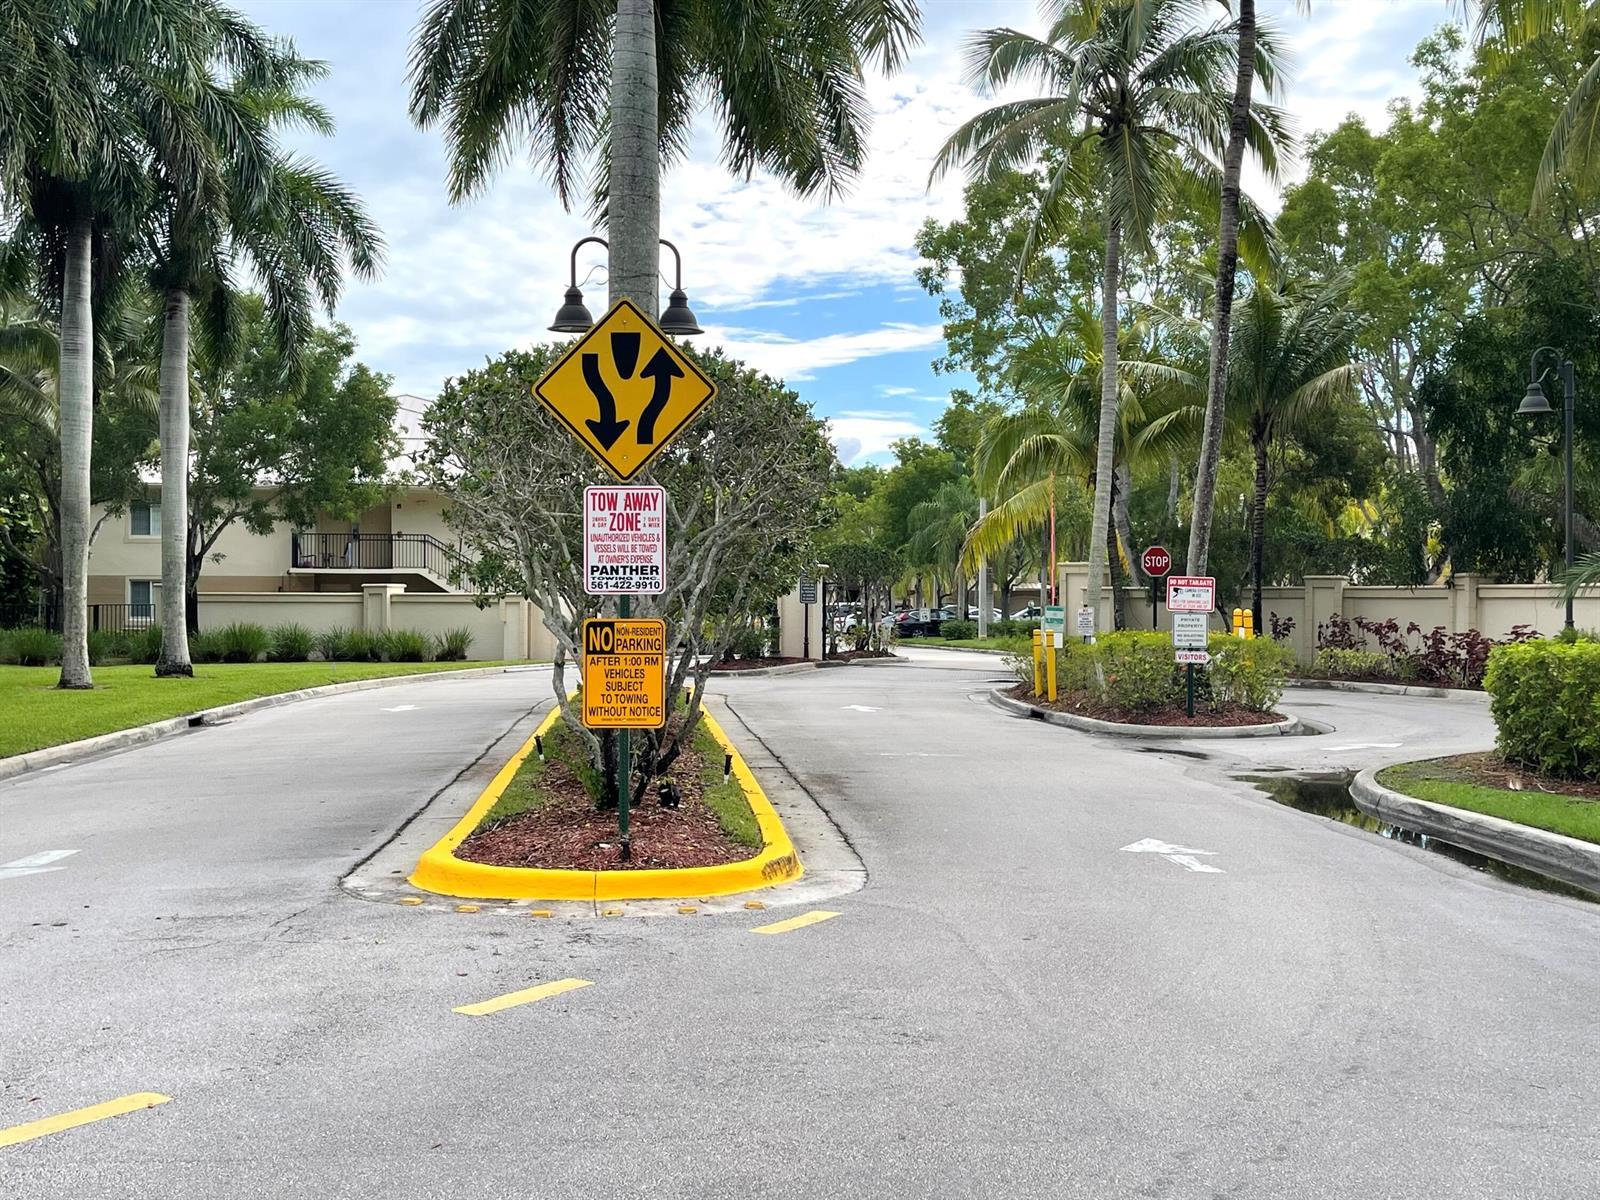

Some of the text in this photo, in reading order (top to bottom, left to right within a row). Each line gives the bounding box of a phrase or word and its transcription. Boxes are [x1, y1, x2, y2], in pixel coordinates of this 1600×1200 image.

[591, 493, 659, 511] TOW AWAY
[610, 513, 640, 531] ZONE
[591, 534, 660, 542] UNAUTHORIZED VEHICLES &
[594, 544, 657, 553] VESSELS WILL BE TOWED
[598, 555, 653, 563] AT OWNER'S EXPENSE
[1145, 556, 1169, 568] STOP
[591, 566, 659, 575] PANTHER
[591, 581, 660, 589] 561-422-9910
[616, 628, 661, 636] NON-RESIDENT
[590, 627, 613, 651] NO
[616, 638, 661, 651] PARKING
[590, 657, 620, 666] AFTER
[624, 657, 641, 666] 1:00
[605, 669, 645, 678] VEHICLES
[606, 682, 643, 691] SUBJECT
[601, 694, 648, 704] TO TOWING
[589, 707, 661, 716] WITHOUT NOTICE
